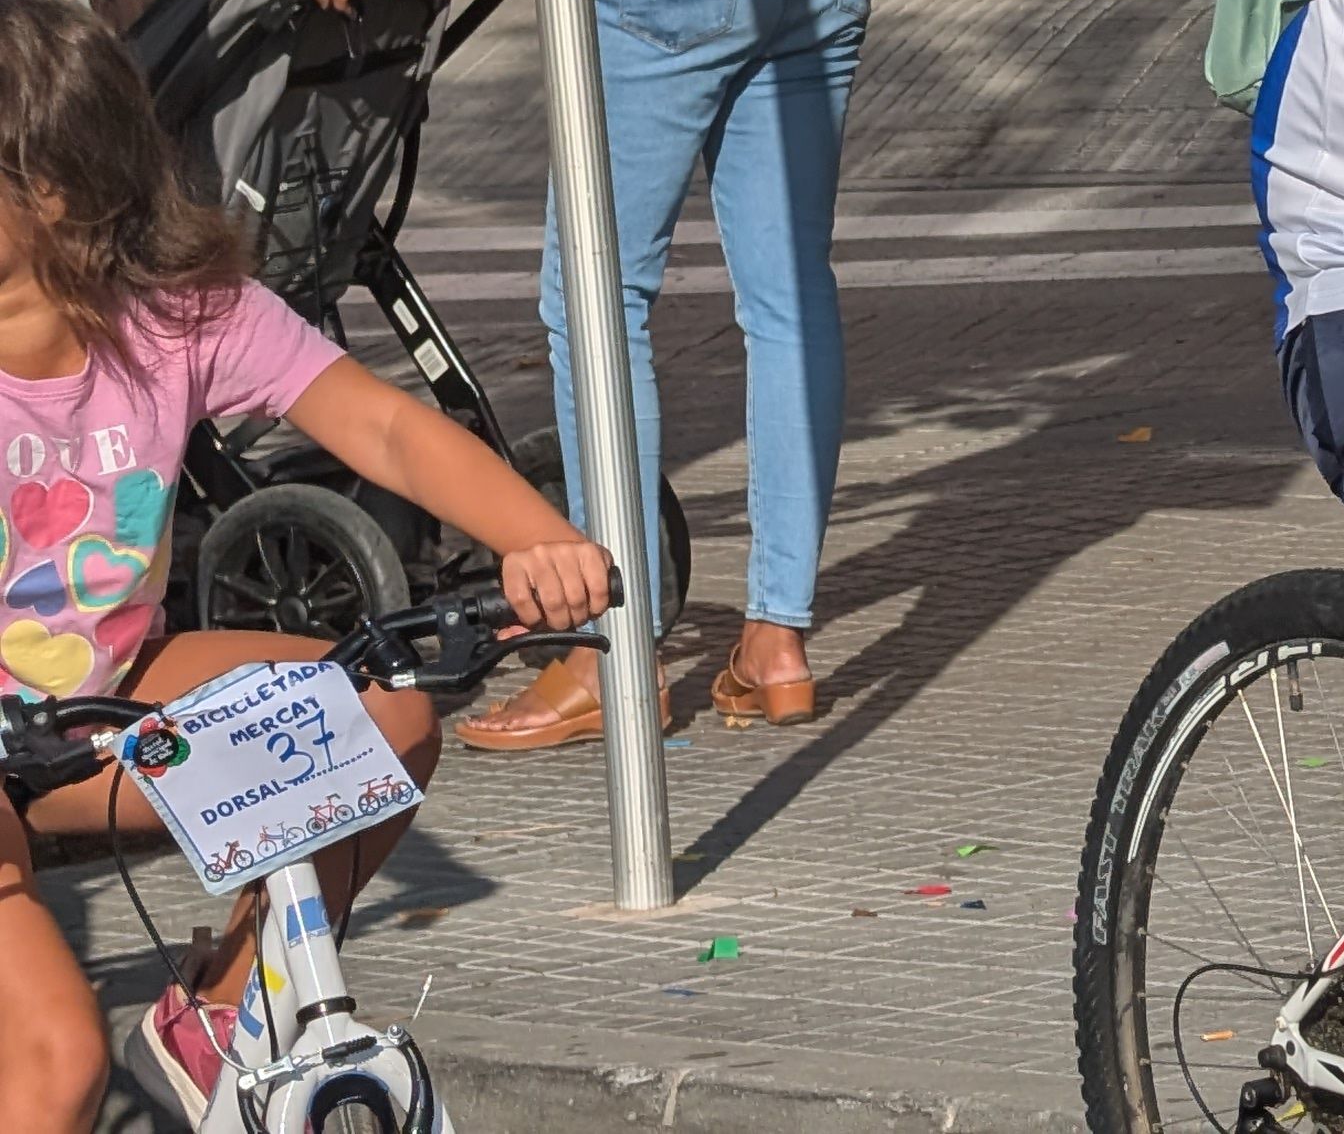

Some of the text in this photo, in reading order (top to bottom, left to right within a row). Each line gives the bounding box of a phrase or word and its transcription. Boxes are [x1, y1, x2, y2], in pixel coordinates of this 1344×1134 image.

[183, 660, 335, 736] BICICLETADA
[229, 695, 322, 747] MERCAT
[267, 710, 336, 786] 37
[200, 778, 289, 825] DORSAL
